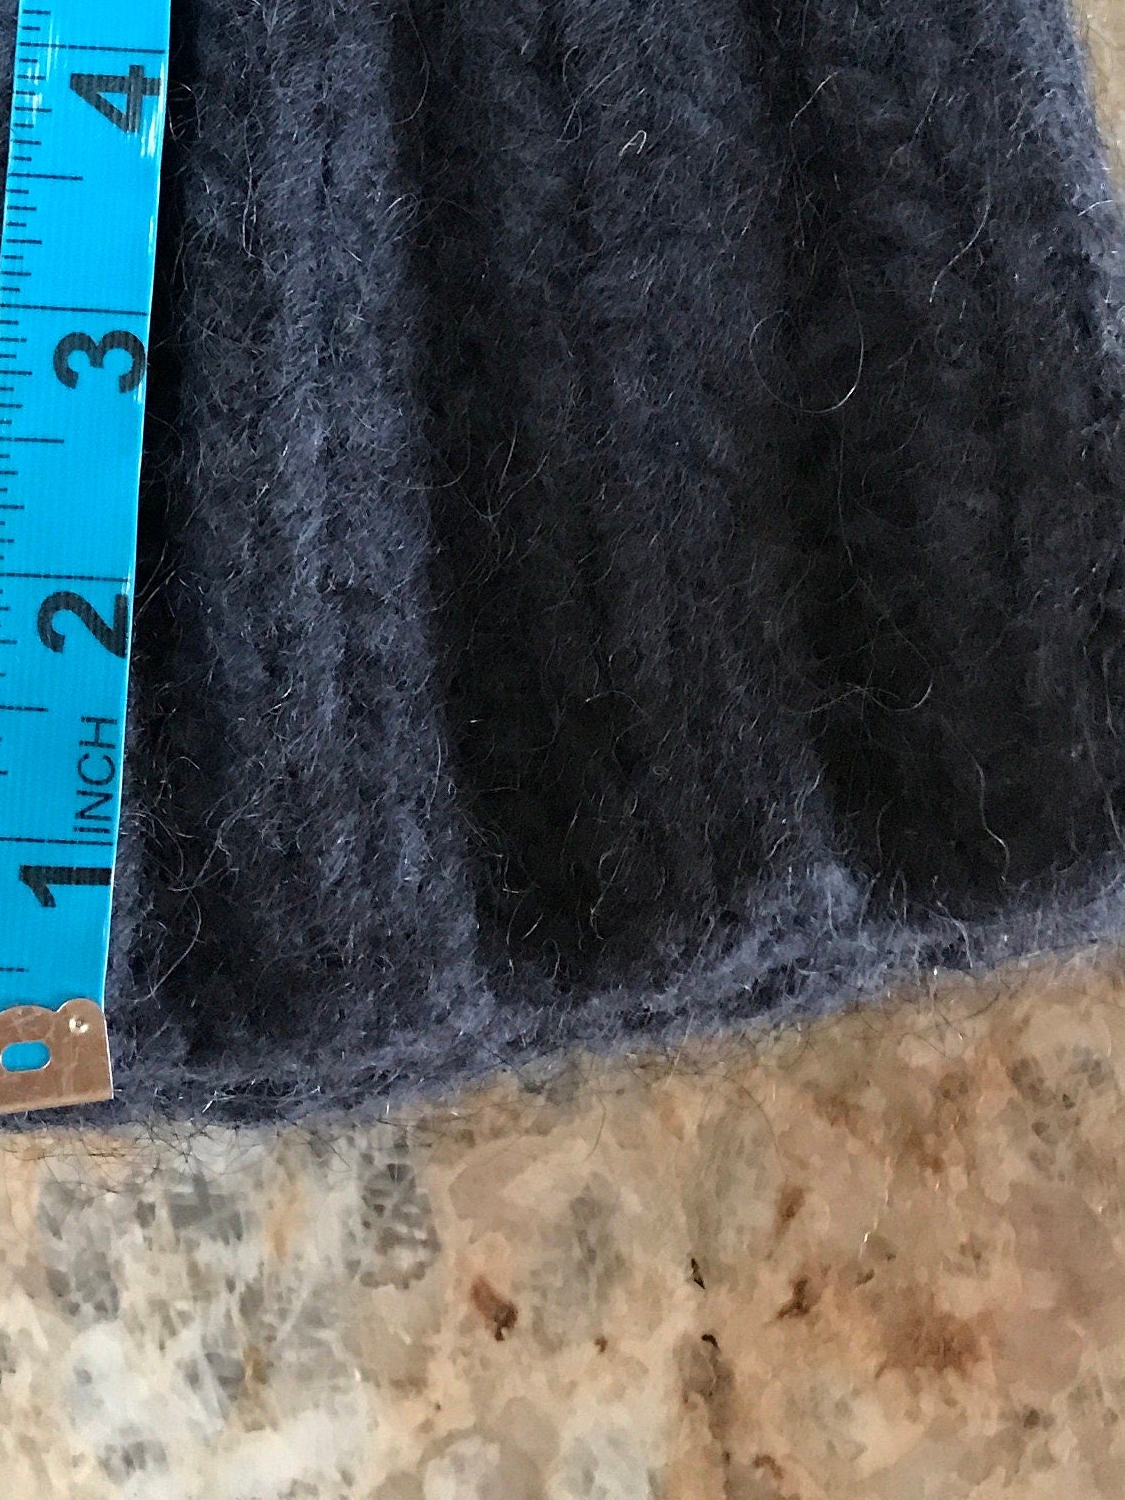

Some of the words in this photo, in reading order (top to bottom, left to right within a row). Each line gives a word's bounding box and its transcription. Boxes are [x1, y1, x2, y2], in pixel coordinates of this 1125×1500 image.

[69, 64, 163, 134] 4
[53, 330, 146, 394] 3
[37, 591, 129, 659] 2
[18, 865, 113, 908] 1
[74, 716, 118, 833] INCH
